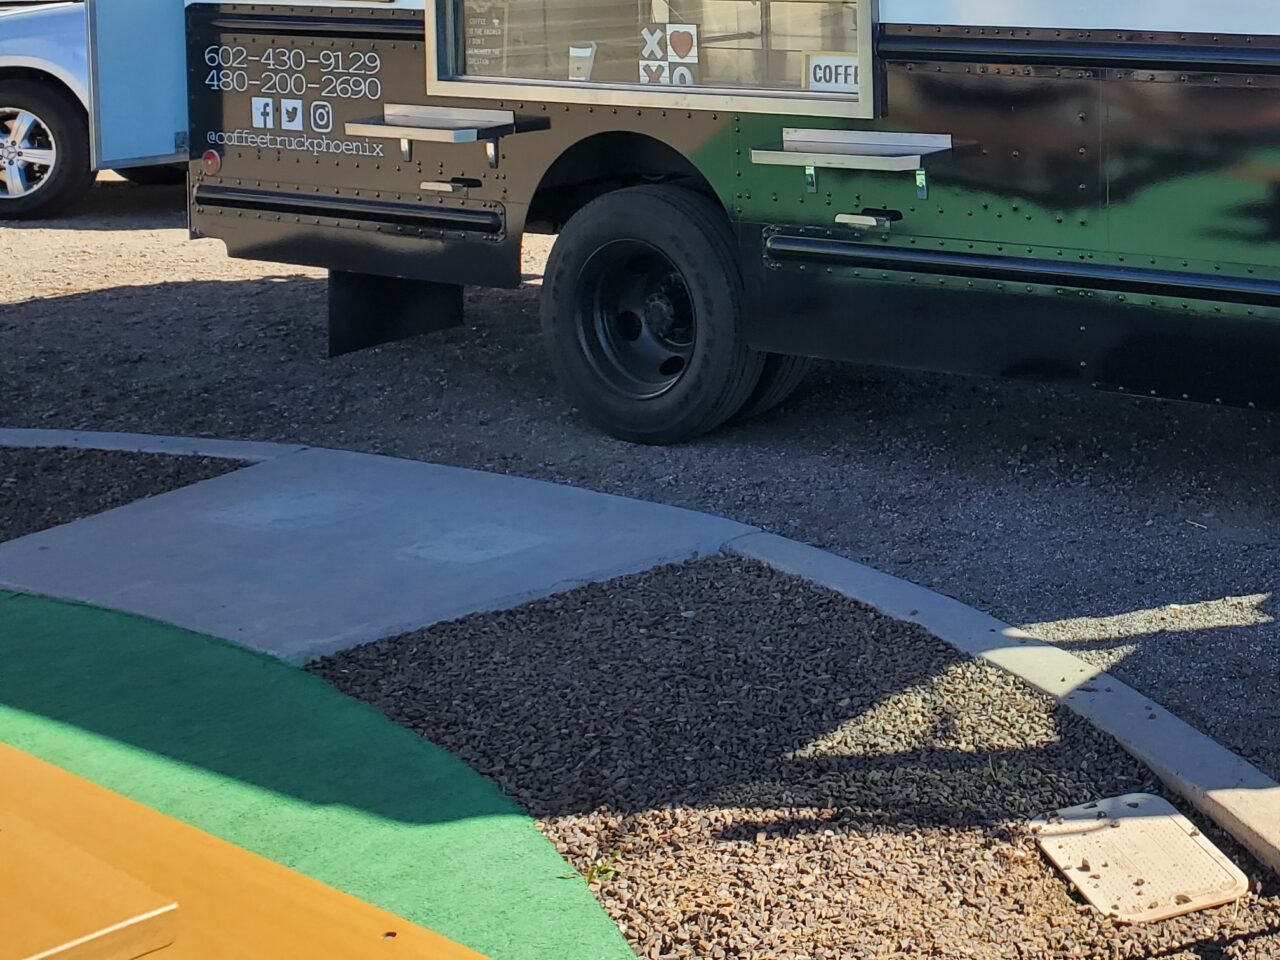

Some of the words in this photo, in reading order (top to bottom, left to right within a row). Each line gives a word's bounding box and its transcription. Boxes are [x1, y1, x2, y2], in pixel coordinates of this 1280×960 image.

[204, 45, 381, 75] 602-430-9129
[204, 69, 381, 100] 480-200-2690
[206, 129, 385, 157] @coffeetruckphoenix
